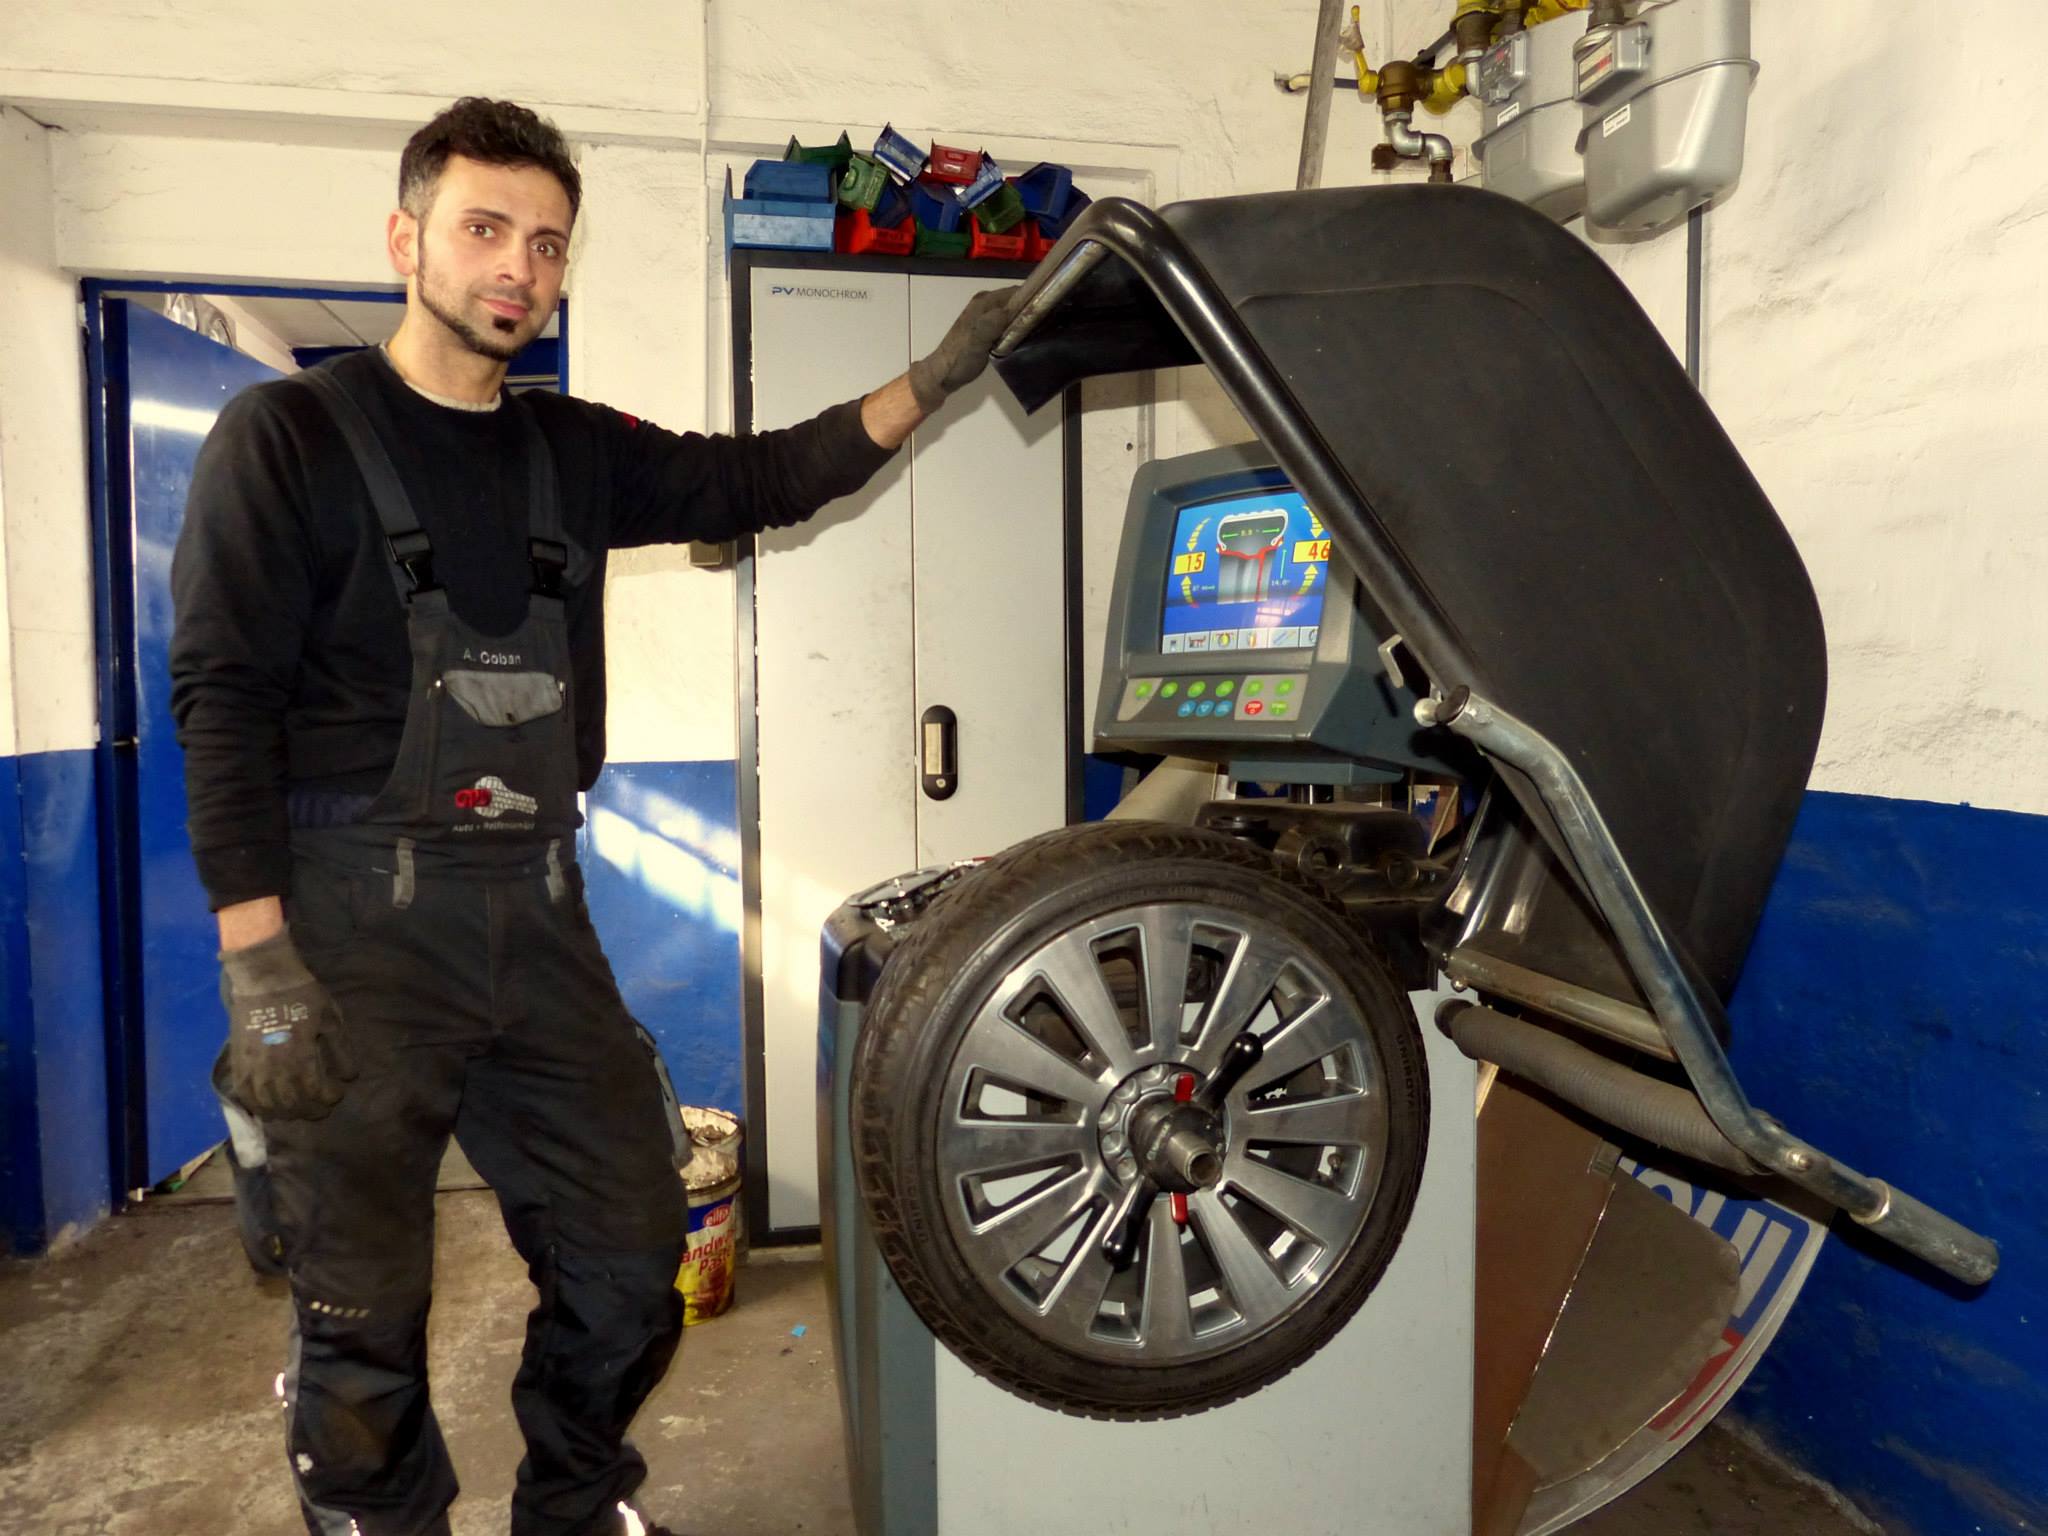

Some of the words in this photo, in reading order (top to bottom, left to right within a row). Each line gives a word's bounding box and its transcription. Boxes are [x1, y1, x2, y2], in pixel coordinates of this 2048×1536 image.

[772, 286, 794, 296] PV
[796, 287, 868, 300] MONOCHROM
[1308, 541, 1329, 560] 46
[1186, 553, 1202, 572] 15
[463, 647, 477, 662] A.
[480, 650, 522, 665] Coban
[1396, 1033, 1416, 1114] UNIROYA
